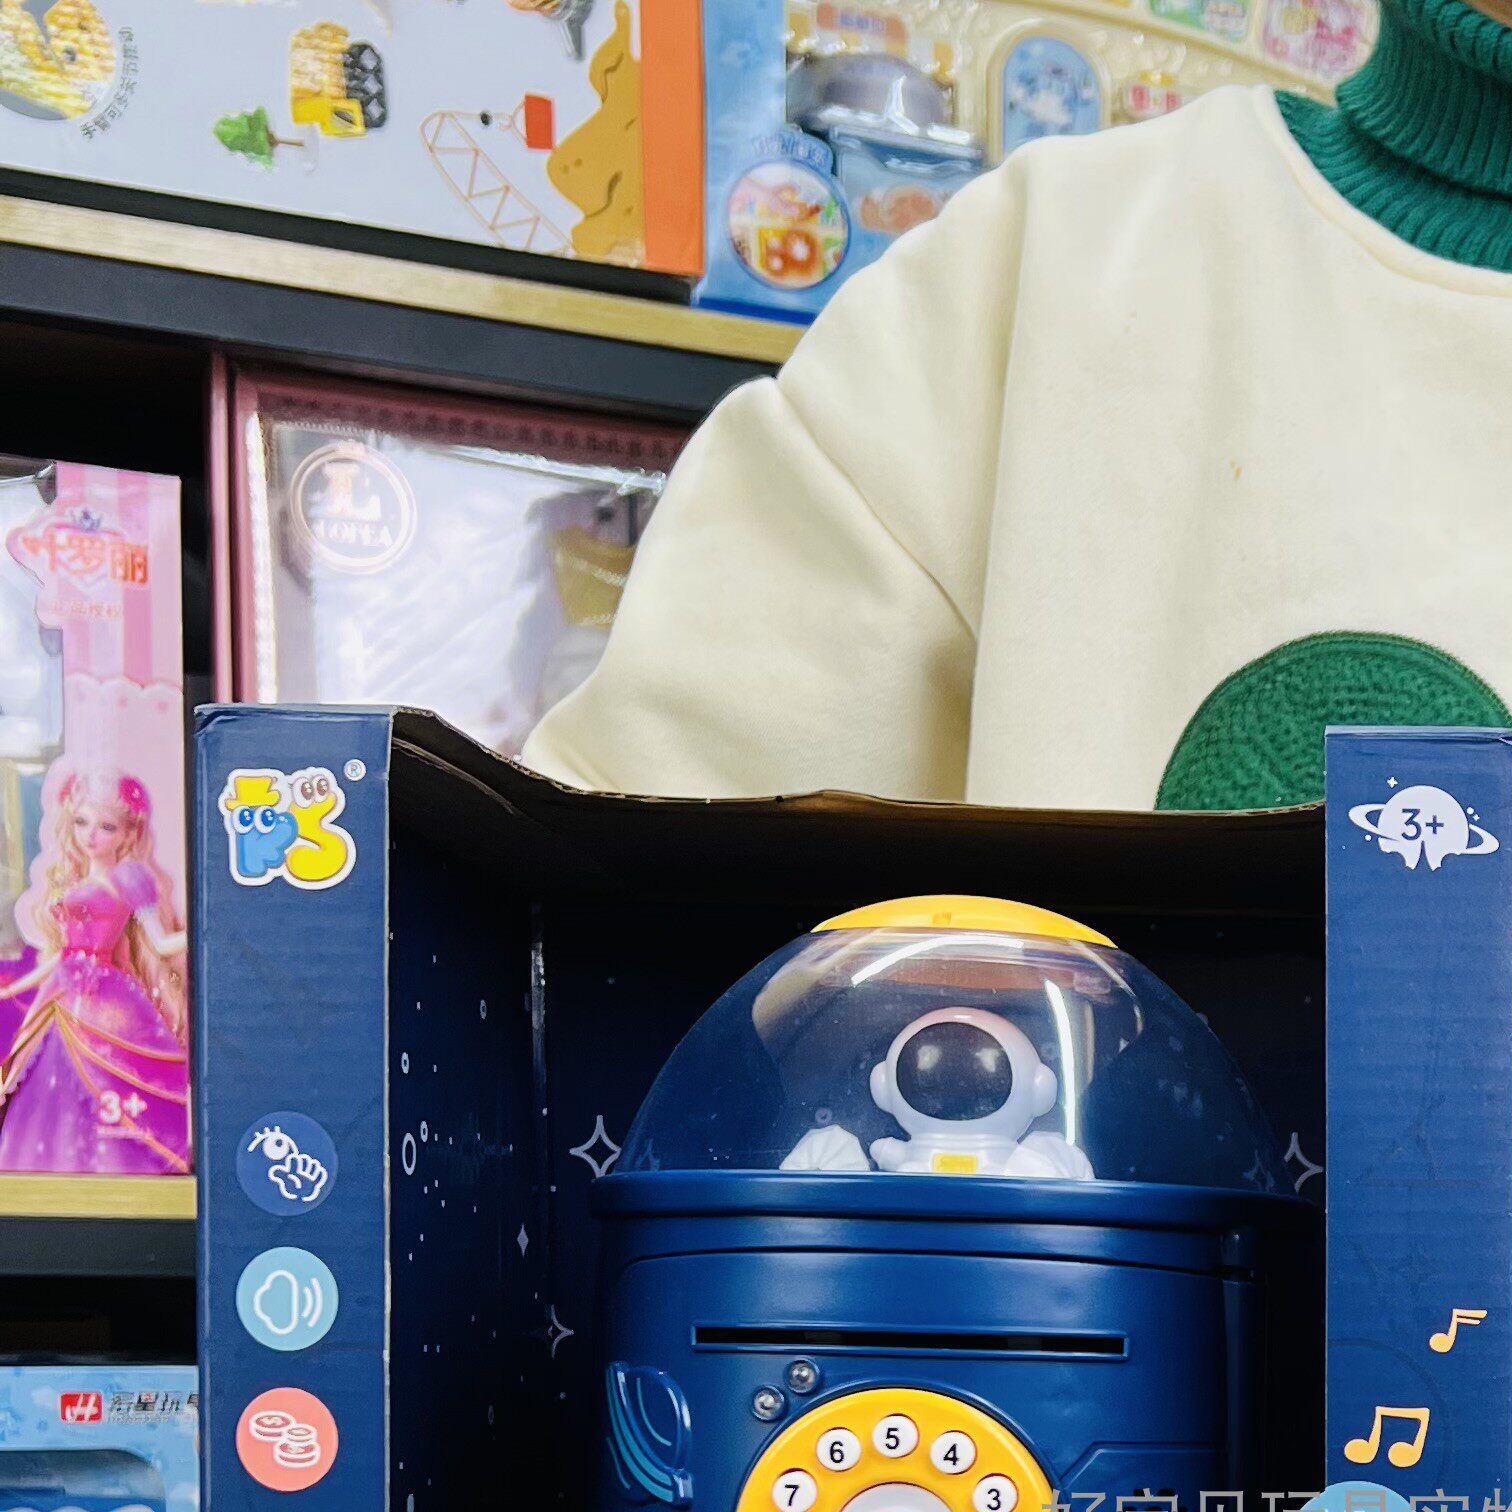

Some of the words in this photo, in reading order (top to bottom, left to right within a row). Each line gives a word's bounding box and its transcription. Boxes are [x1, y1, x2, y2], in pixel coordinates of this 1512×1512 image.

[1401, 807, 1445, 841] 3+
[99, 1091, 148, 1124] 3+
[885, 1427, 900, 1450] 5
[829, 1440, 845, 1464] 6
[942, 1443, 960, 1467] 4
[784, 1483, 800, 1507] 7
[986, 1488, 1002, 1511] 3
